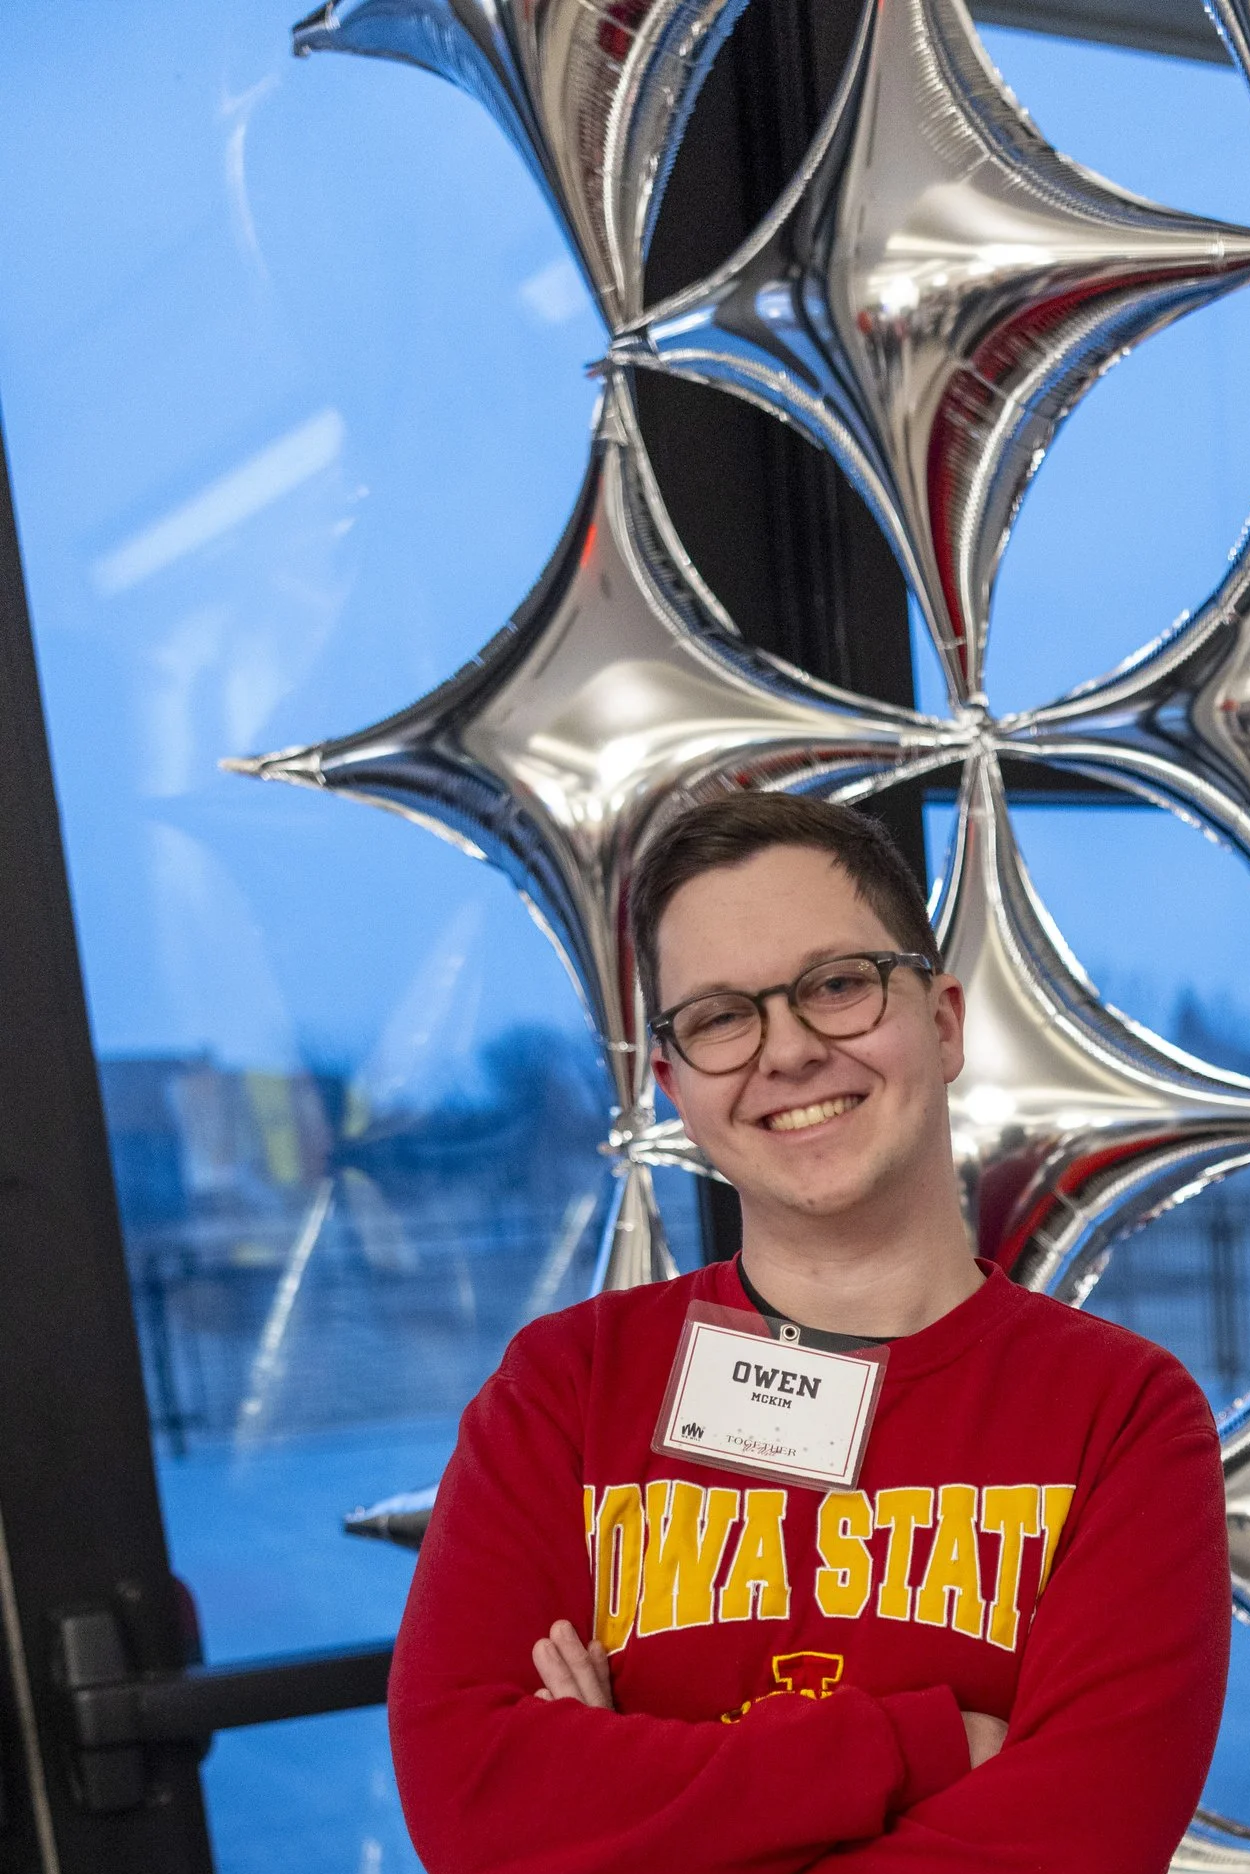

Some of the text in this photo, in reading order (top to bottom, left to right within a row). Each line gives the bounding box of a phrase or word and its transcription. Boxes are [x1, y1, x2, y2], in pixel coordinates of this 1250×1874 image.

[732, 1360, 822, 1399] OWEN
[751, 1391, 792, 1410] MCKIM
[726, 1434, 797, 1457] TOGETHER
[584, 1480, 791, 1657] OWA
